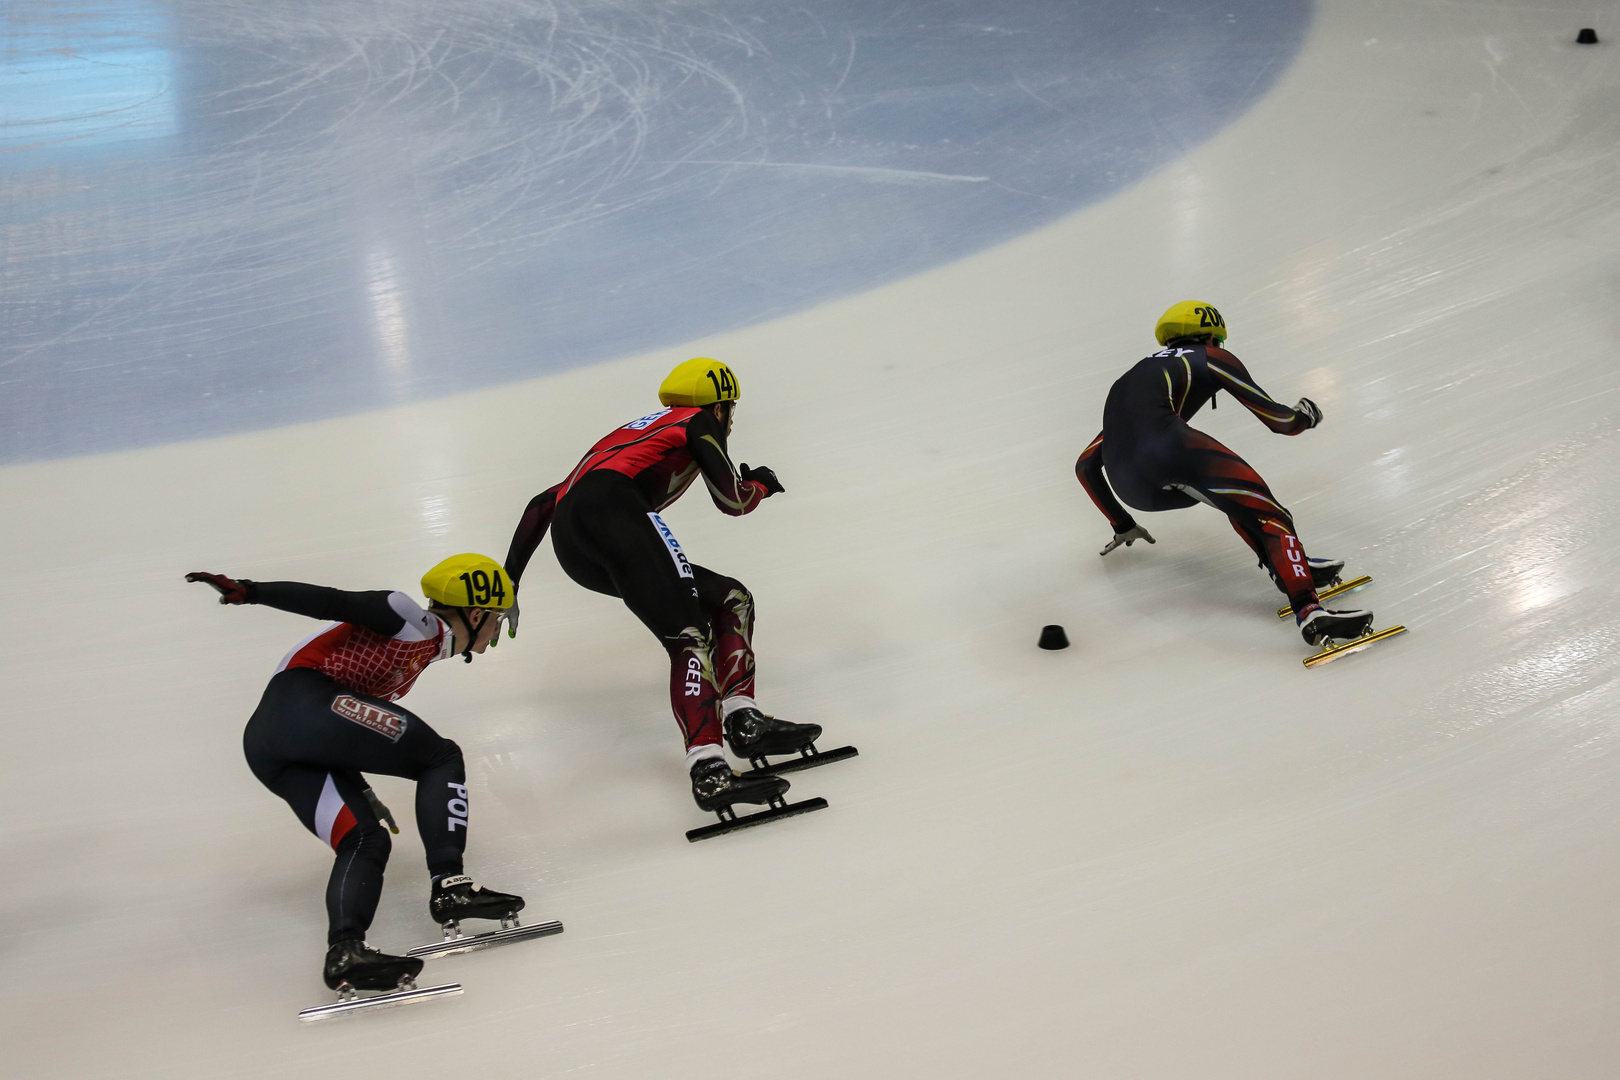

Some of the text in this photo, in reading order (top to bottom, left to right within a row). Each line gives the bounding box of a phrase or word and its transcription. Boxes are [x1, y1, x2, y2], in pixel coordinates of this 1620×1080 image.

[1147, 347, 1195, 358] EY
[706, 366, 737, 400] 141
[1285, 534, 1307, 577] TUR
[459, 569, 505, 605] 194
[684, 657, 701, 697] GER
[447, 782, 468, 832] POL
